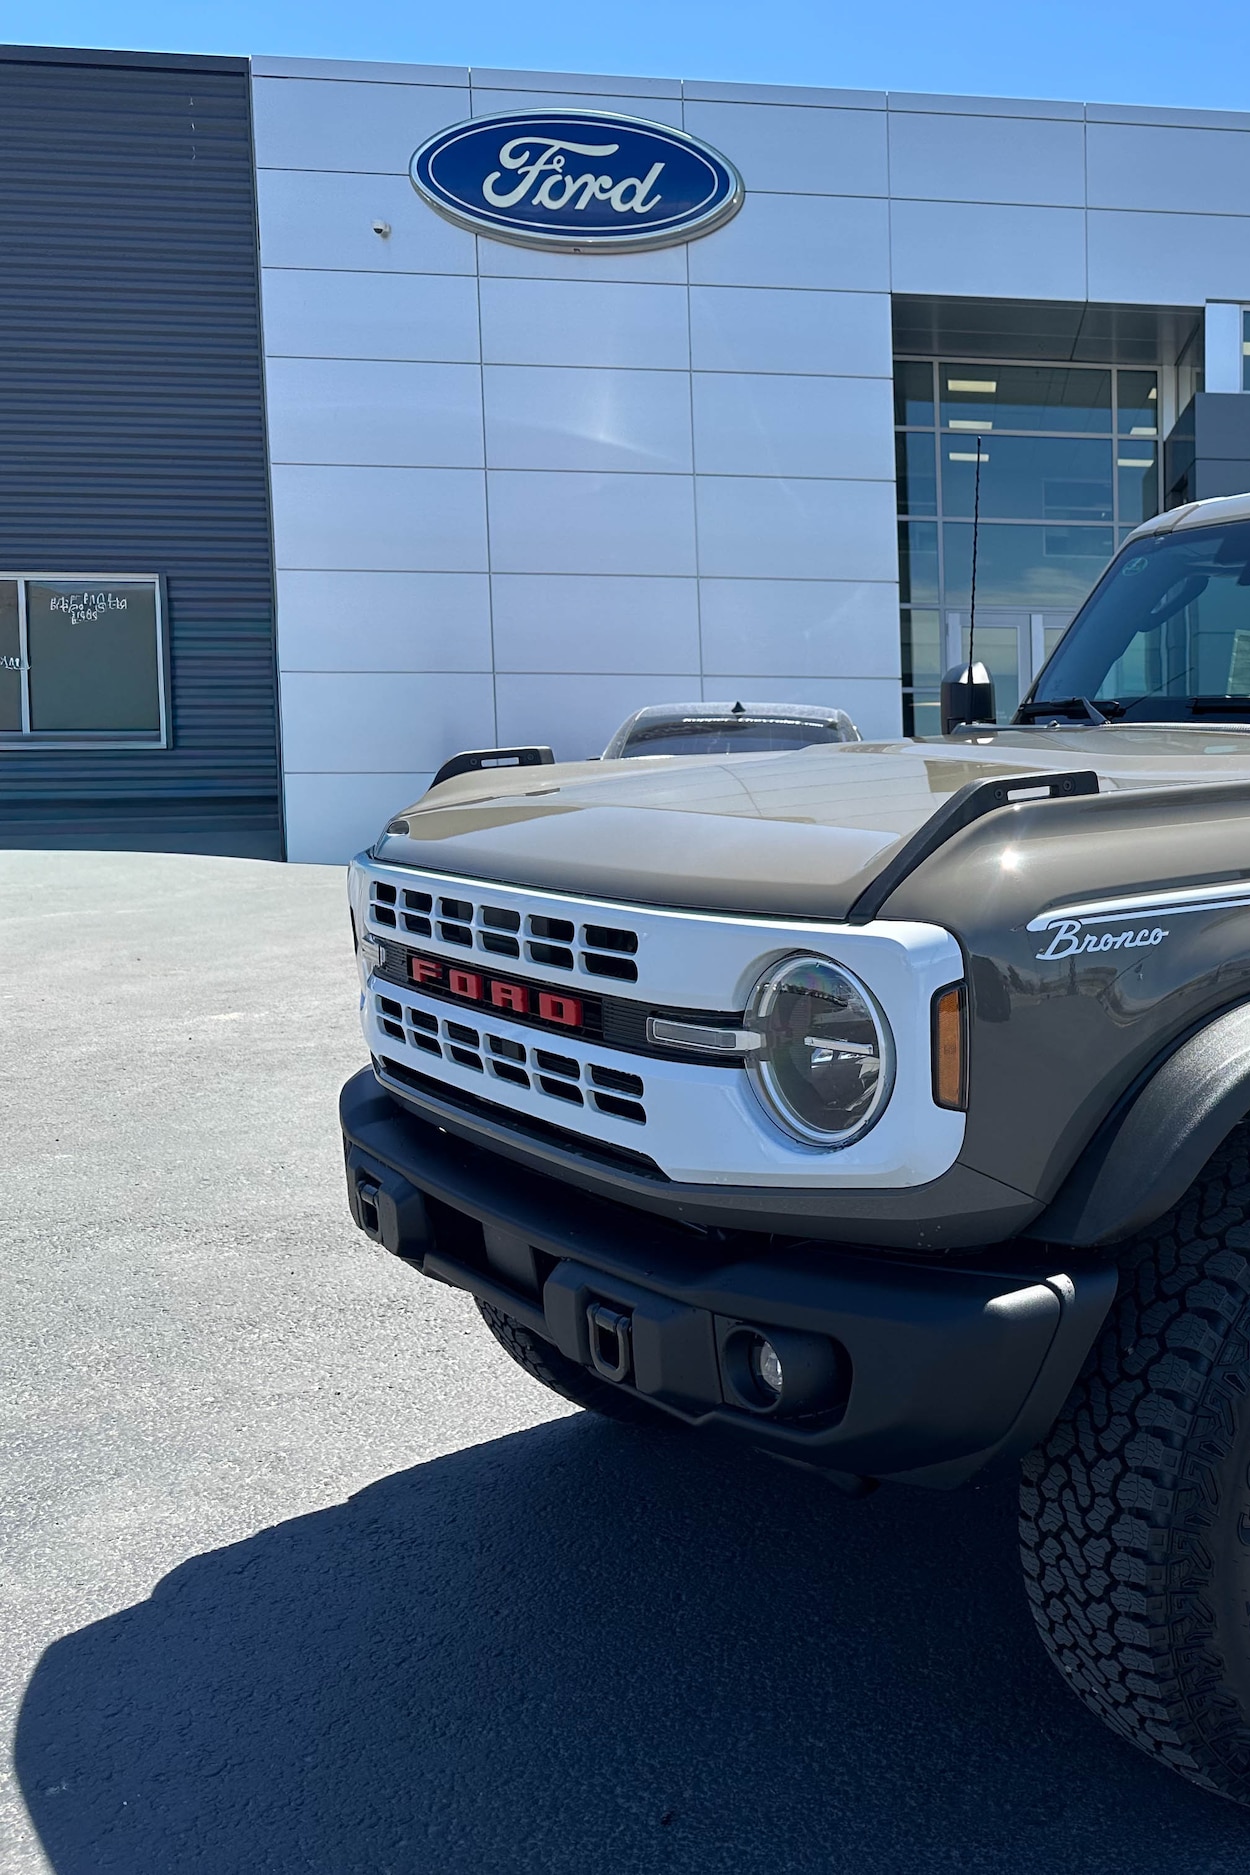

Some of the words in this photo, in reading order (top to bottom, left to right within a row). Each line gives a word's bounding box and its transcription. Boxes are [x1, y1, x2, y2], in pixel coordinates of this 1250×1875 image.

[482, 137, 666, 214] Ford
[1035, 919, 1170, 961] Bronco
[411, 957, 584, 1027] FORD
